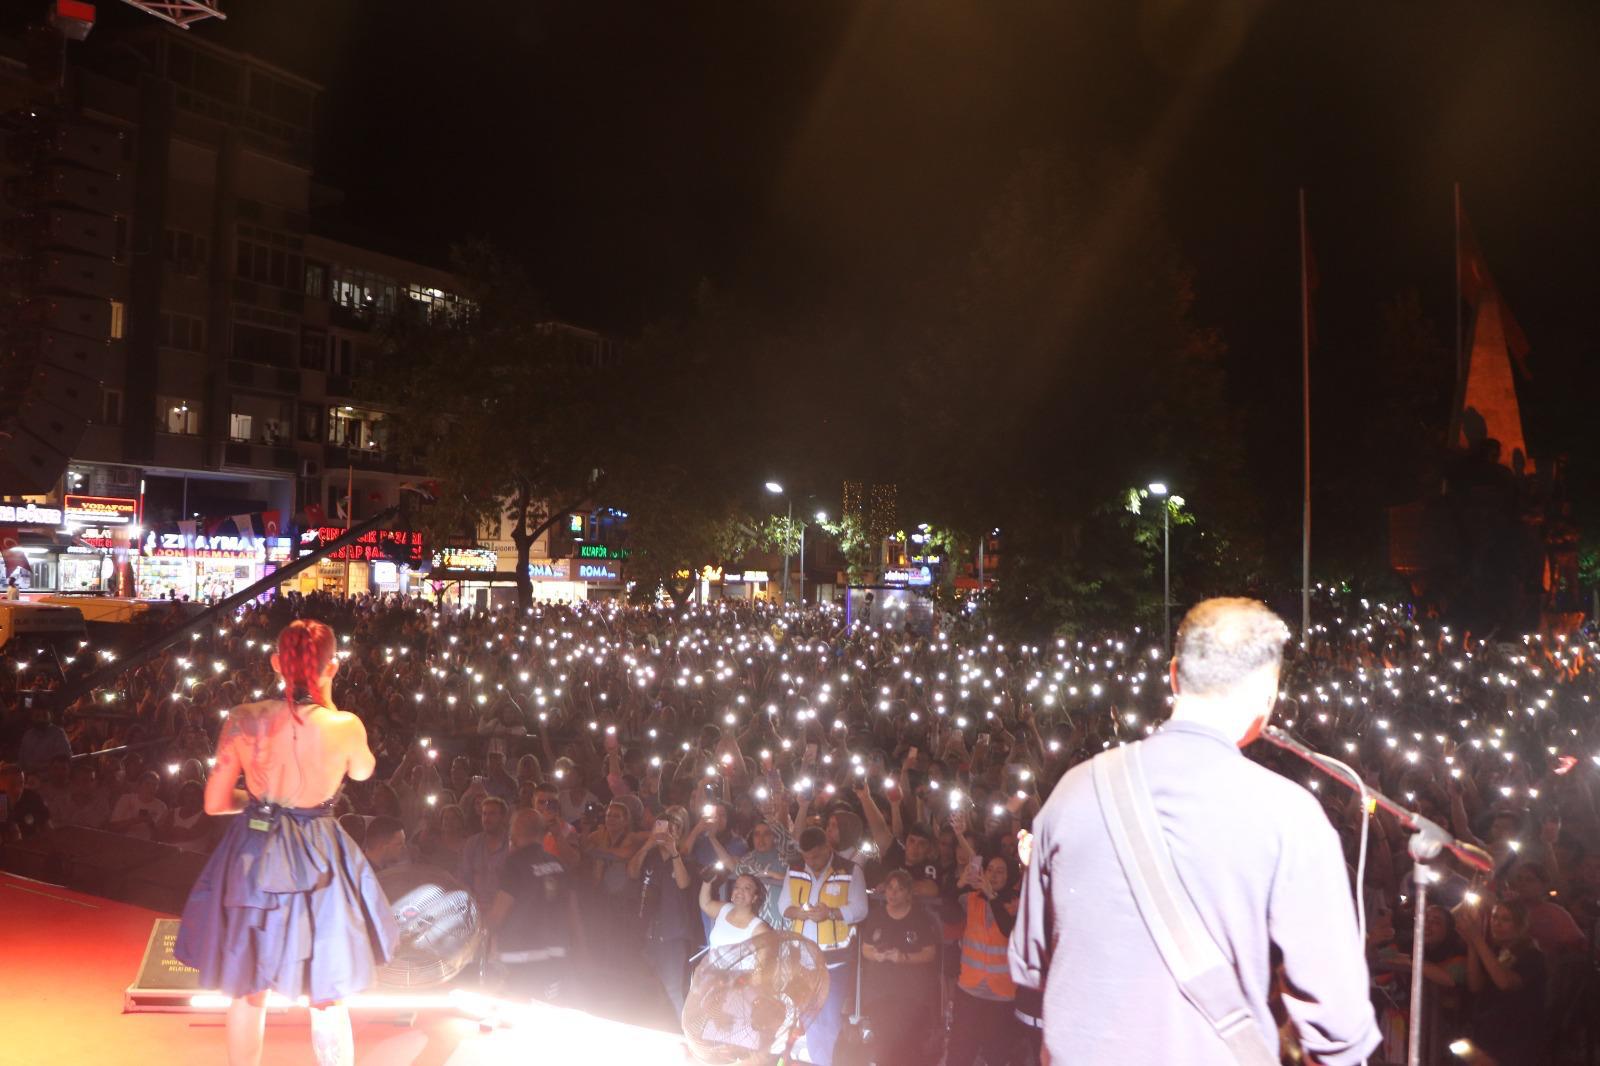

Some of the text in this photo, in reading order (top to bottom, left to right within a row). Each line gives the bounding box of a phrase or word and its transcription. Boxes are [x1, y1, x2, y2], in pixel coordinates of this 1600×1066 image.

[16, 504, 61, 523] DÖNER
[529, 564, 553, 577] OMA
[580, 565, 607, 577] ROMA
